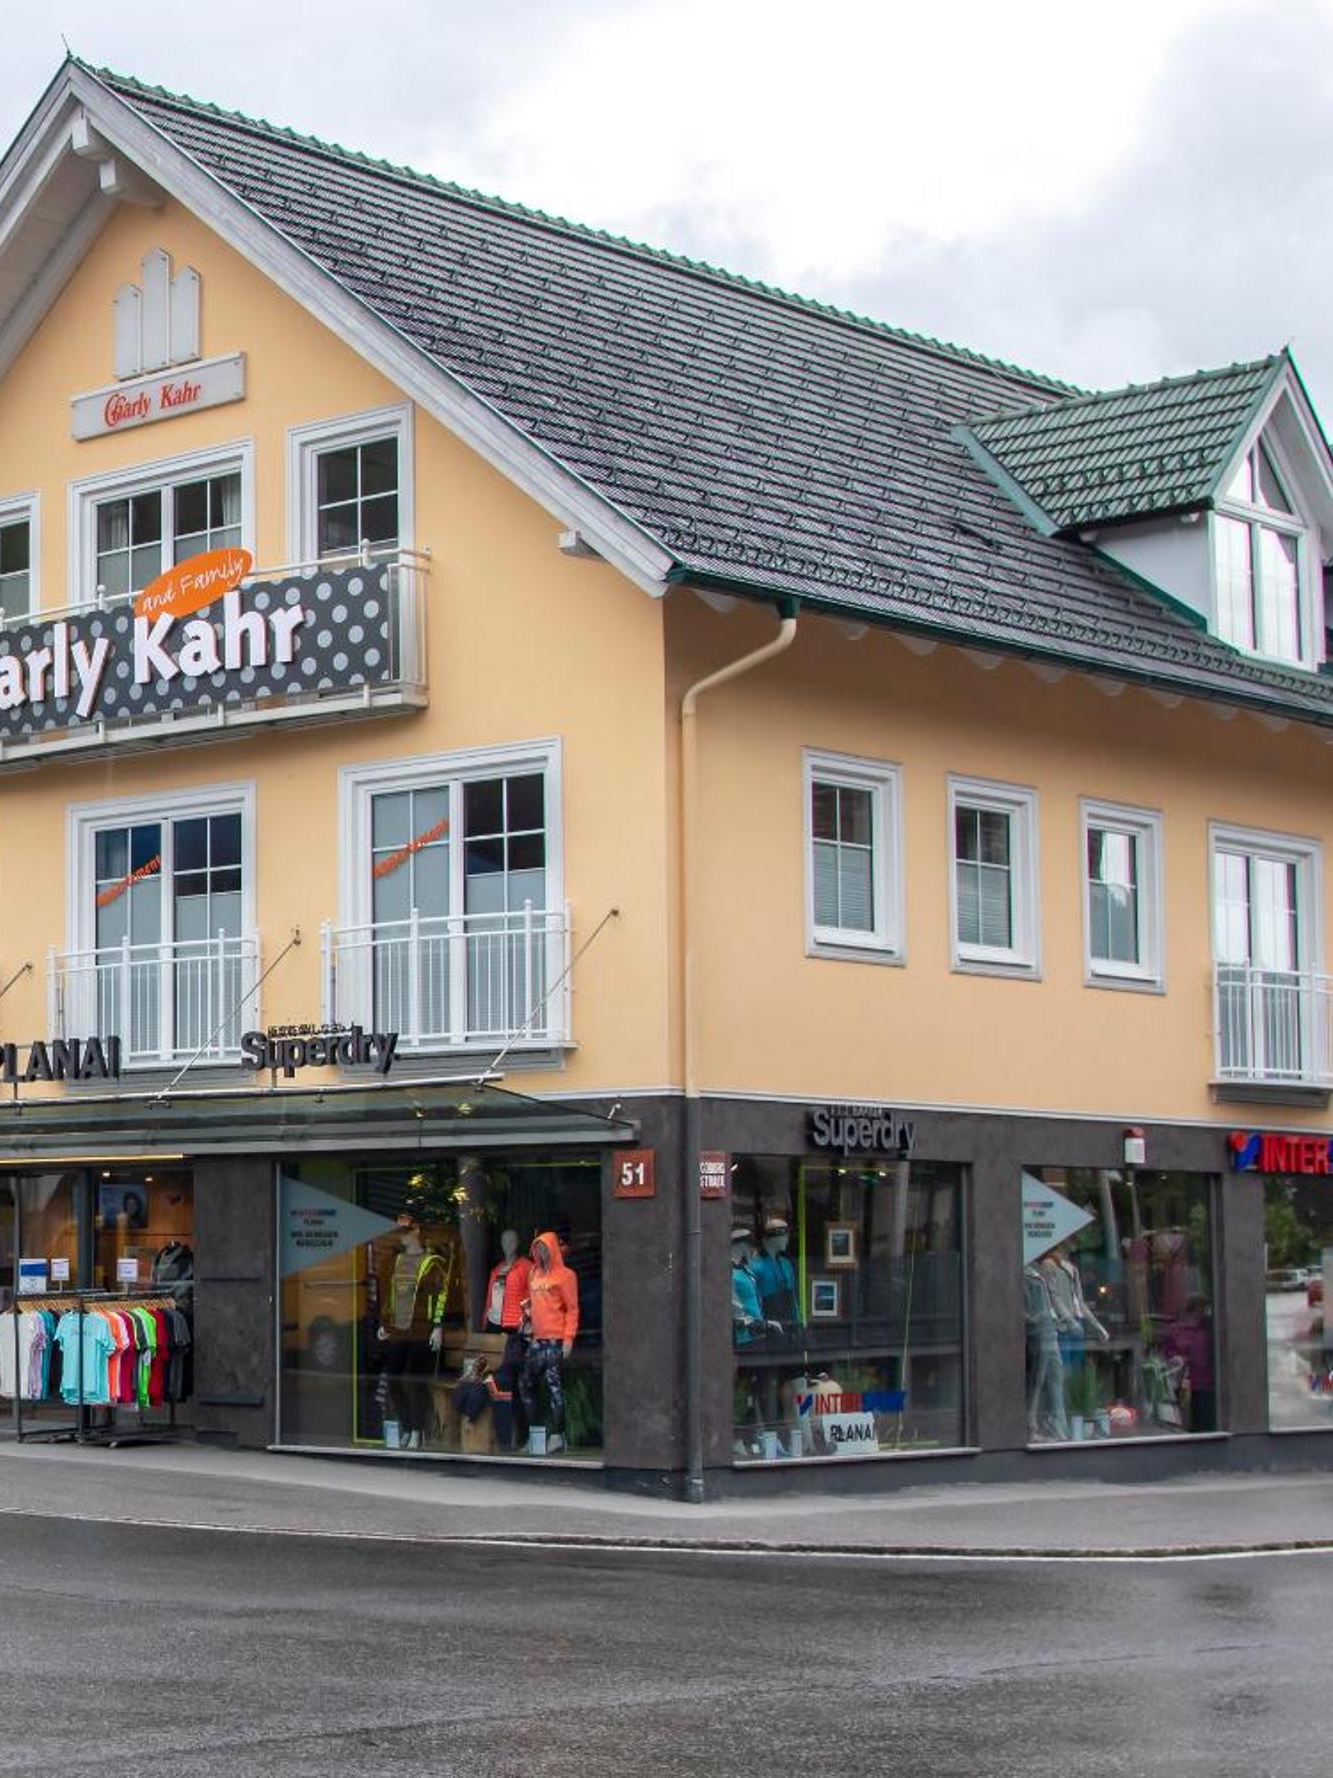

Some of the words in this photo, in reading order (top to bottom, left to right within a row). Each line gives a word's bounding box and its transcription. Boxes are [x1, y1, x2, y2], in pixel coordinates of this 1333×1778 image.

[159, 380, 201, 410] Kahr
[141, 580, 177, 612] and
[180, 550, 244, 596] Family
[133, 590, 306, 685] Kahr
[240, 1024, 399, 1079] Superdry
[812, 1109, 916, 1159] Superdry
[1261, 1134, 1333, 1174] INTER
[621, 1161, 645, 1187] 51
